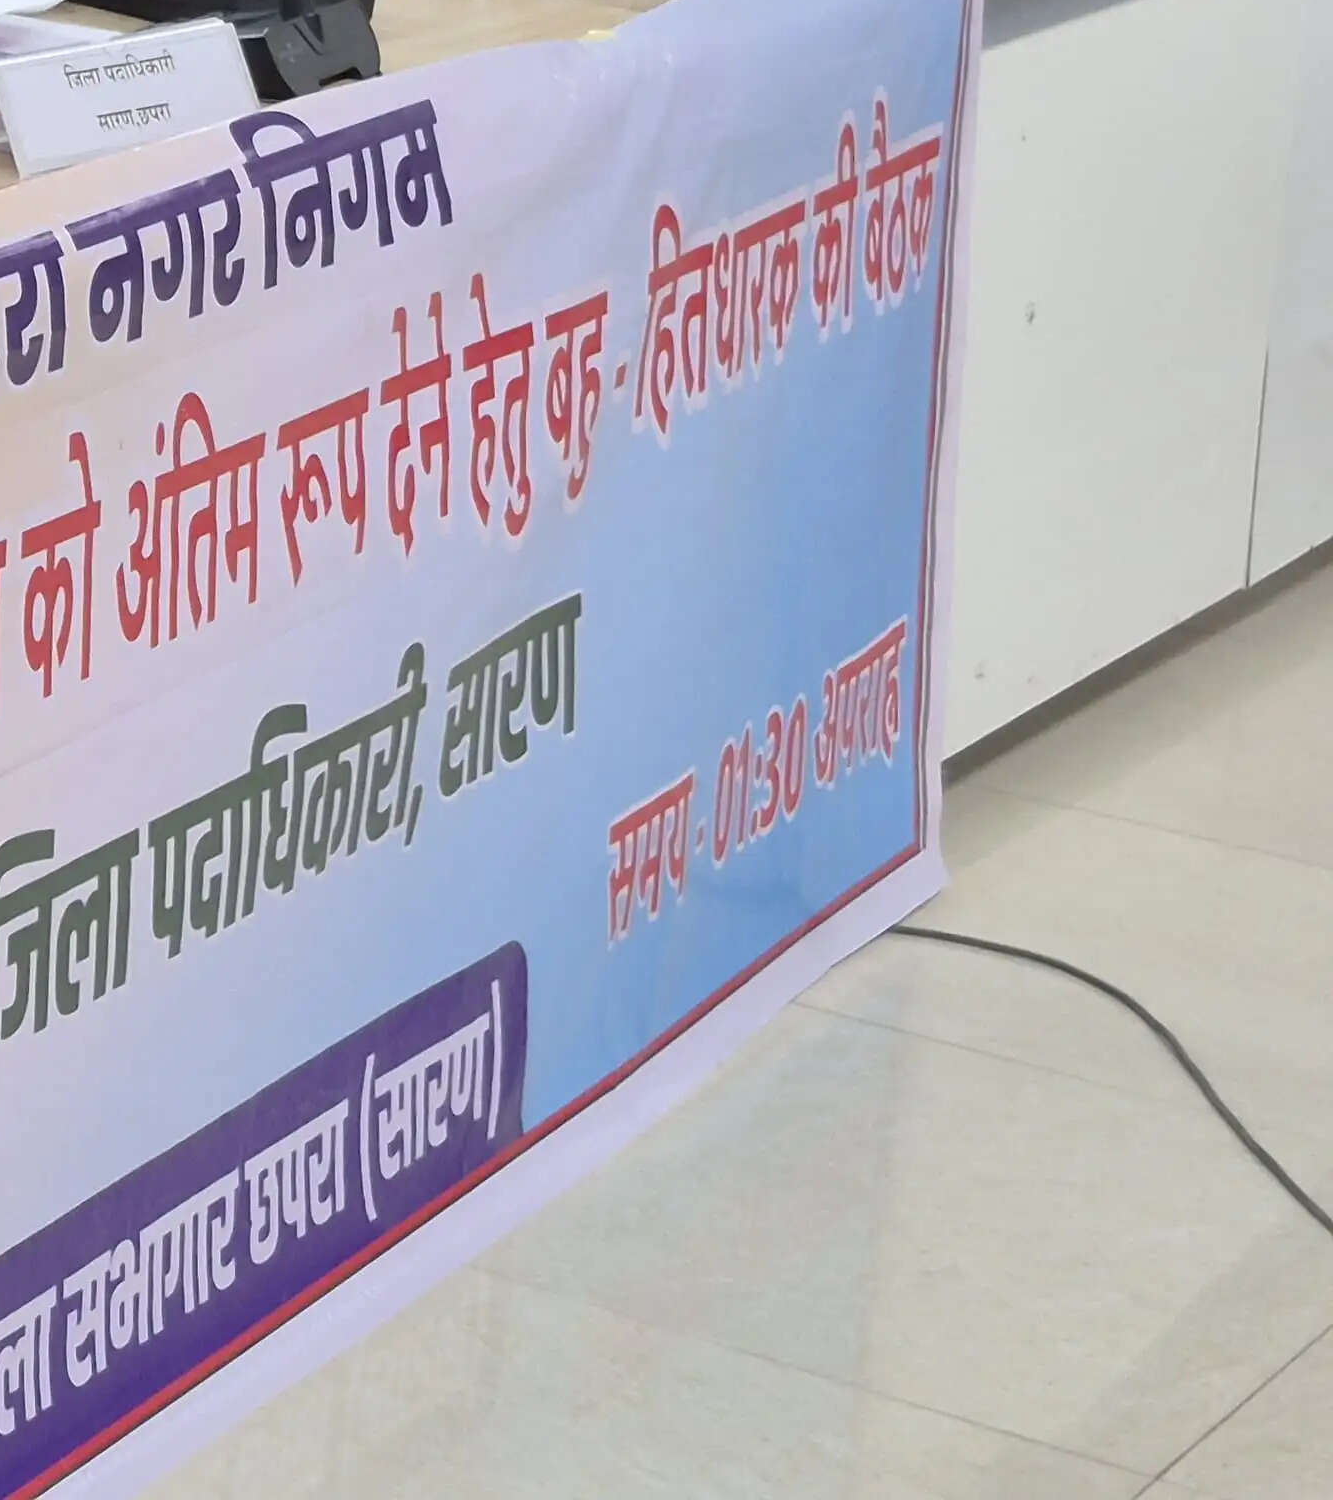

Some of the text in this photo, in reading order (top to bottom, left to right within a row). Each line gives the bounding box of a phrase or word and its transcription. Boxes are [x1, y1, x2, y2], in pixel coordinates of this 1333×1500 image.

[64, 48, 176, 89] जिला पदाधिकारी
[66, 169, 245, 343] नगर
[229, 99, 453, 290] निगम
[21, 432, 101, 697] को
[116, 391, 266, 647] अंतिम
[278, 389, 370, 585] रूप
[381, 292, 452, 556] देने
[463, 274, 535, 537] हेतु
[546, 290, 608, 501] बहु
[636, 205, 806, 434] हितधारक
[813, 124, 858, 322] की
[866, 98, 940, 297] बैठक
[149, 642, 427, 958] पदाधिकारी,
[438, 593, 582, 798] सारण
[607, 773, 695, 941] समय
[714, 699, 807, 863] 01:30
[62, 1171, 237, 1386] सभागार
[244, 1098, 348, 1266] छपरा
[358, 980, 504, 1221] (सारण)
